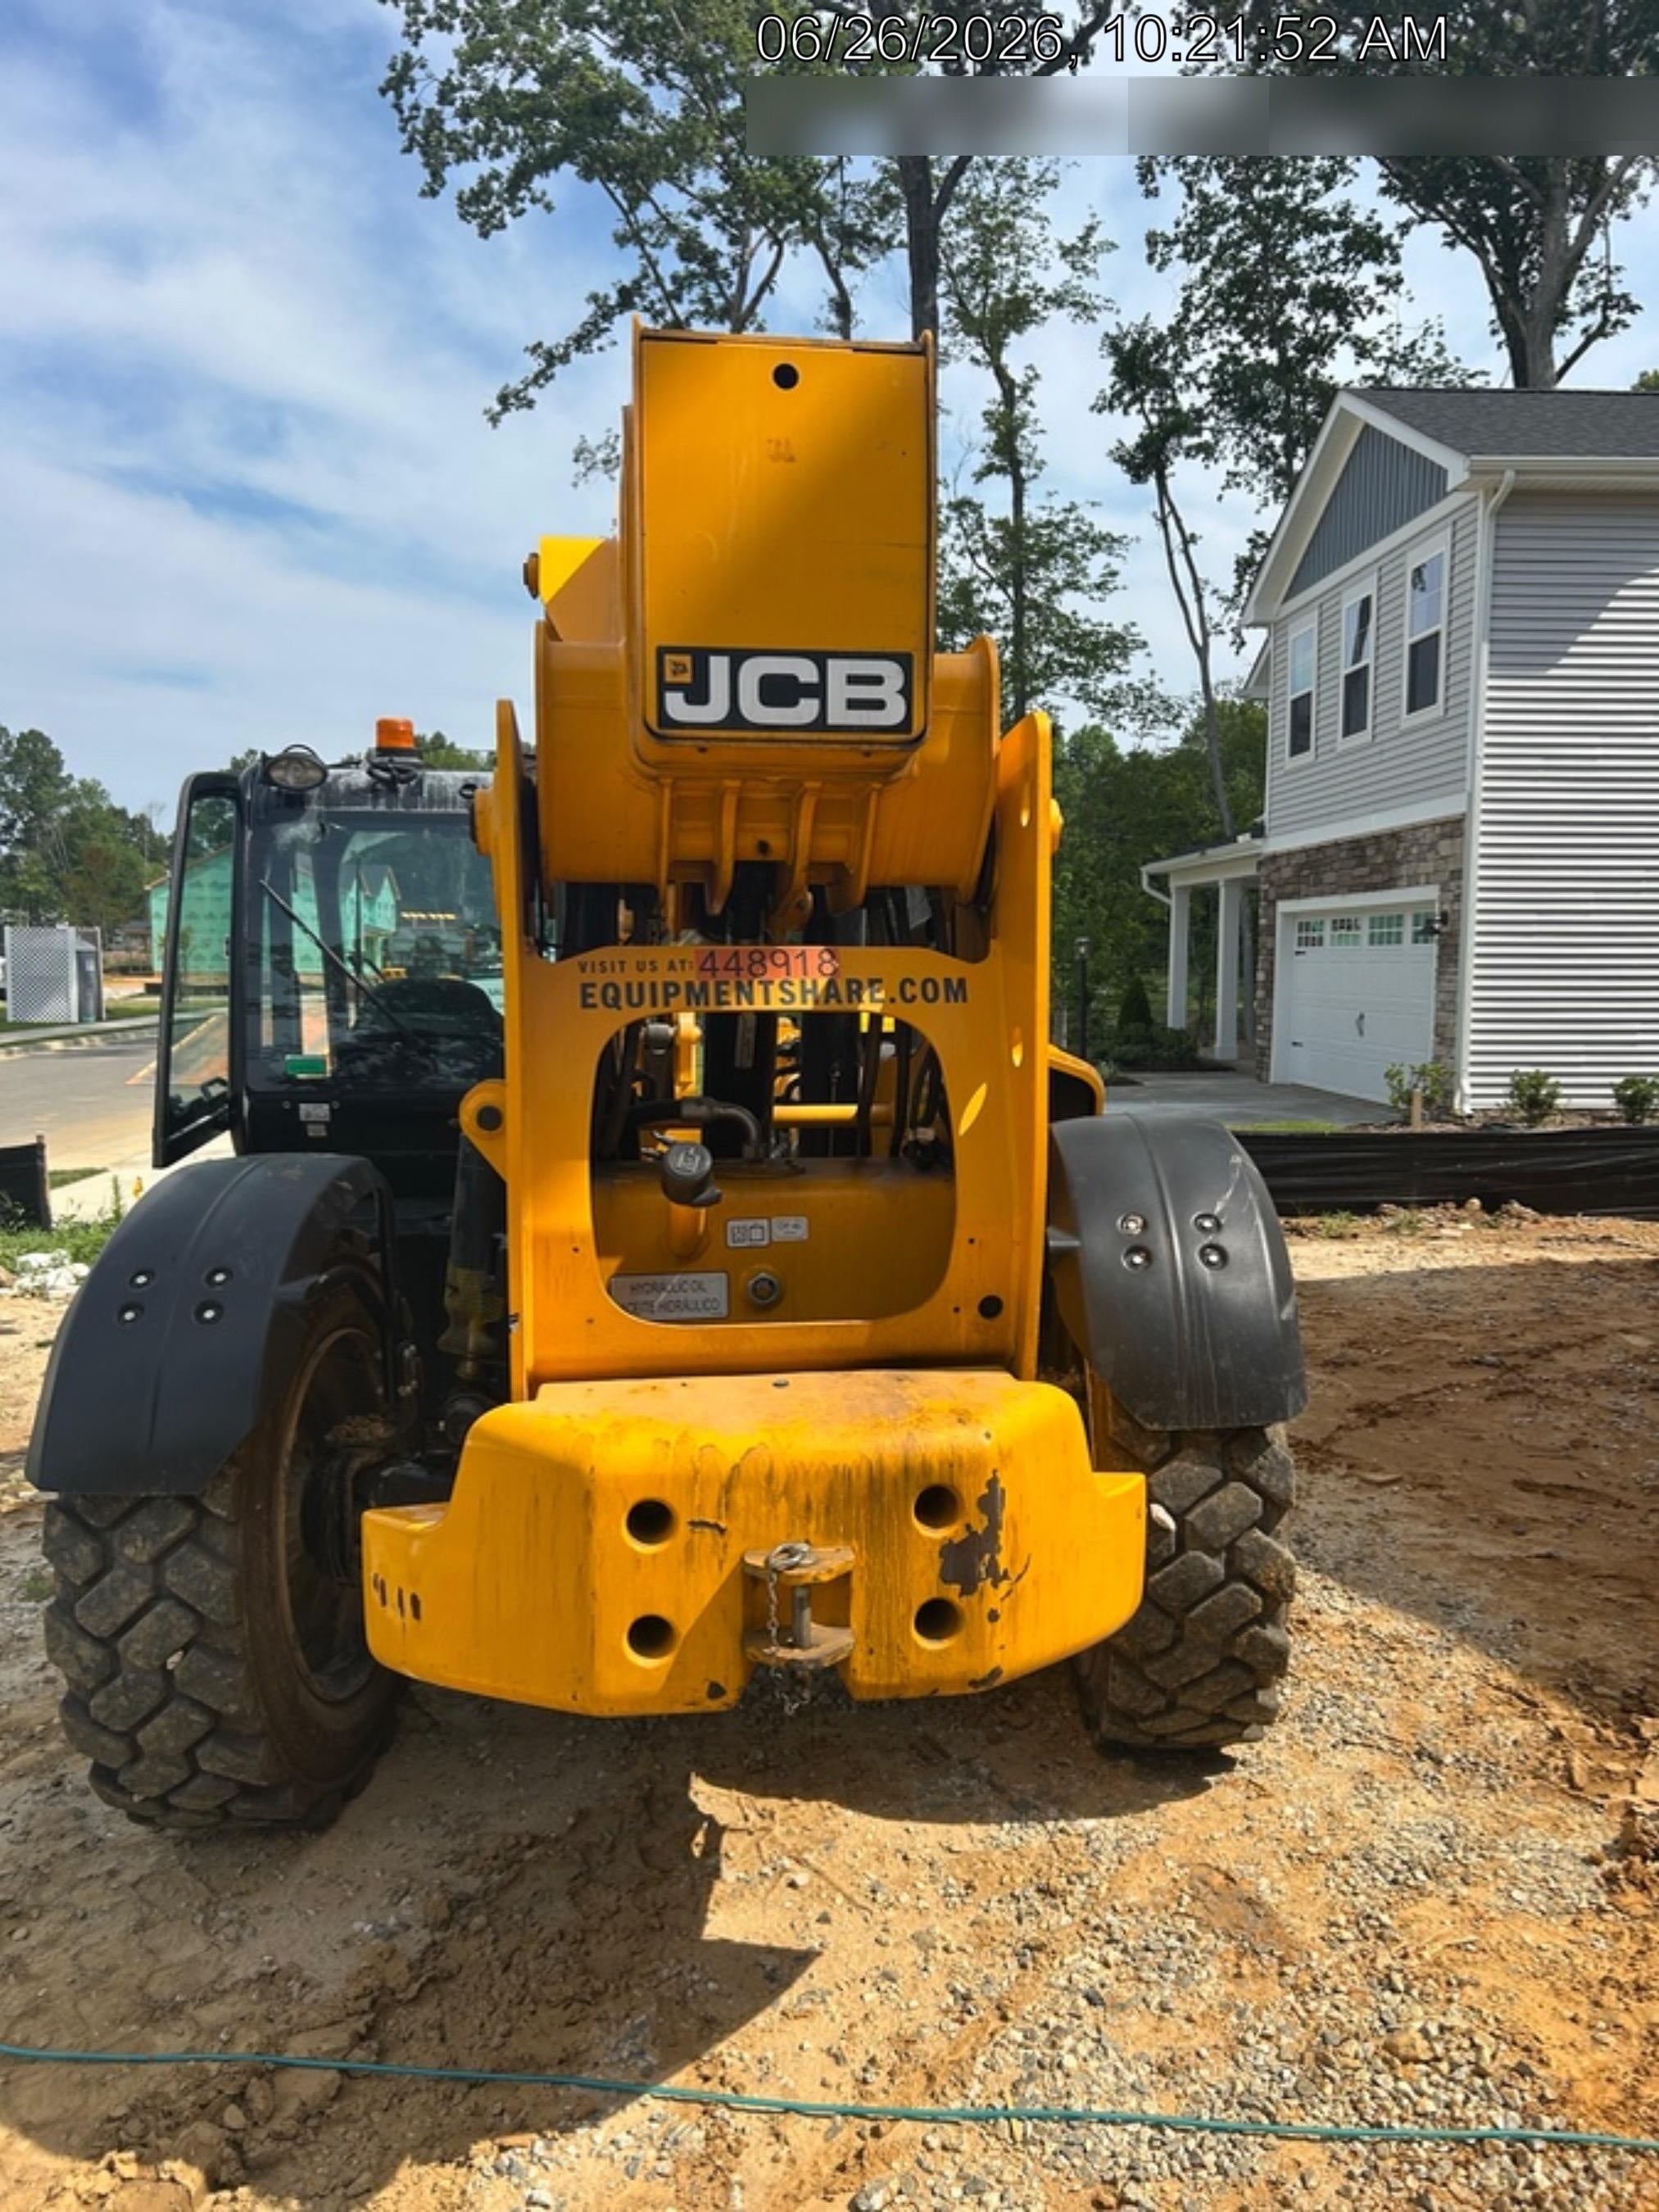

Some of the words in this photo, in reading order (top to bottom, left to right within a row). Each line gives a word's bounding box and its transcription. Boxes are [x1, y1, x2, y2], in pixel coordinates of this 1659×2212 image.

[664, 655, 907, 726] JCB
[578, 961, 626, 973] VISIT
[636, 961, 658, 972] US
[699, 949, 839, 977] 448918
[580, 977, 968, 1010] EQUIPMENTSHARE.COM
